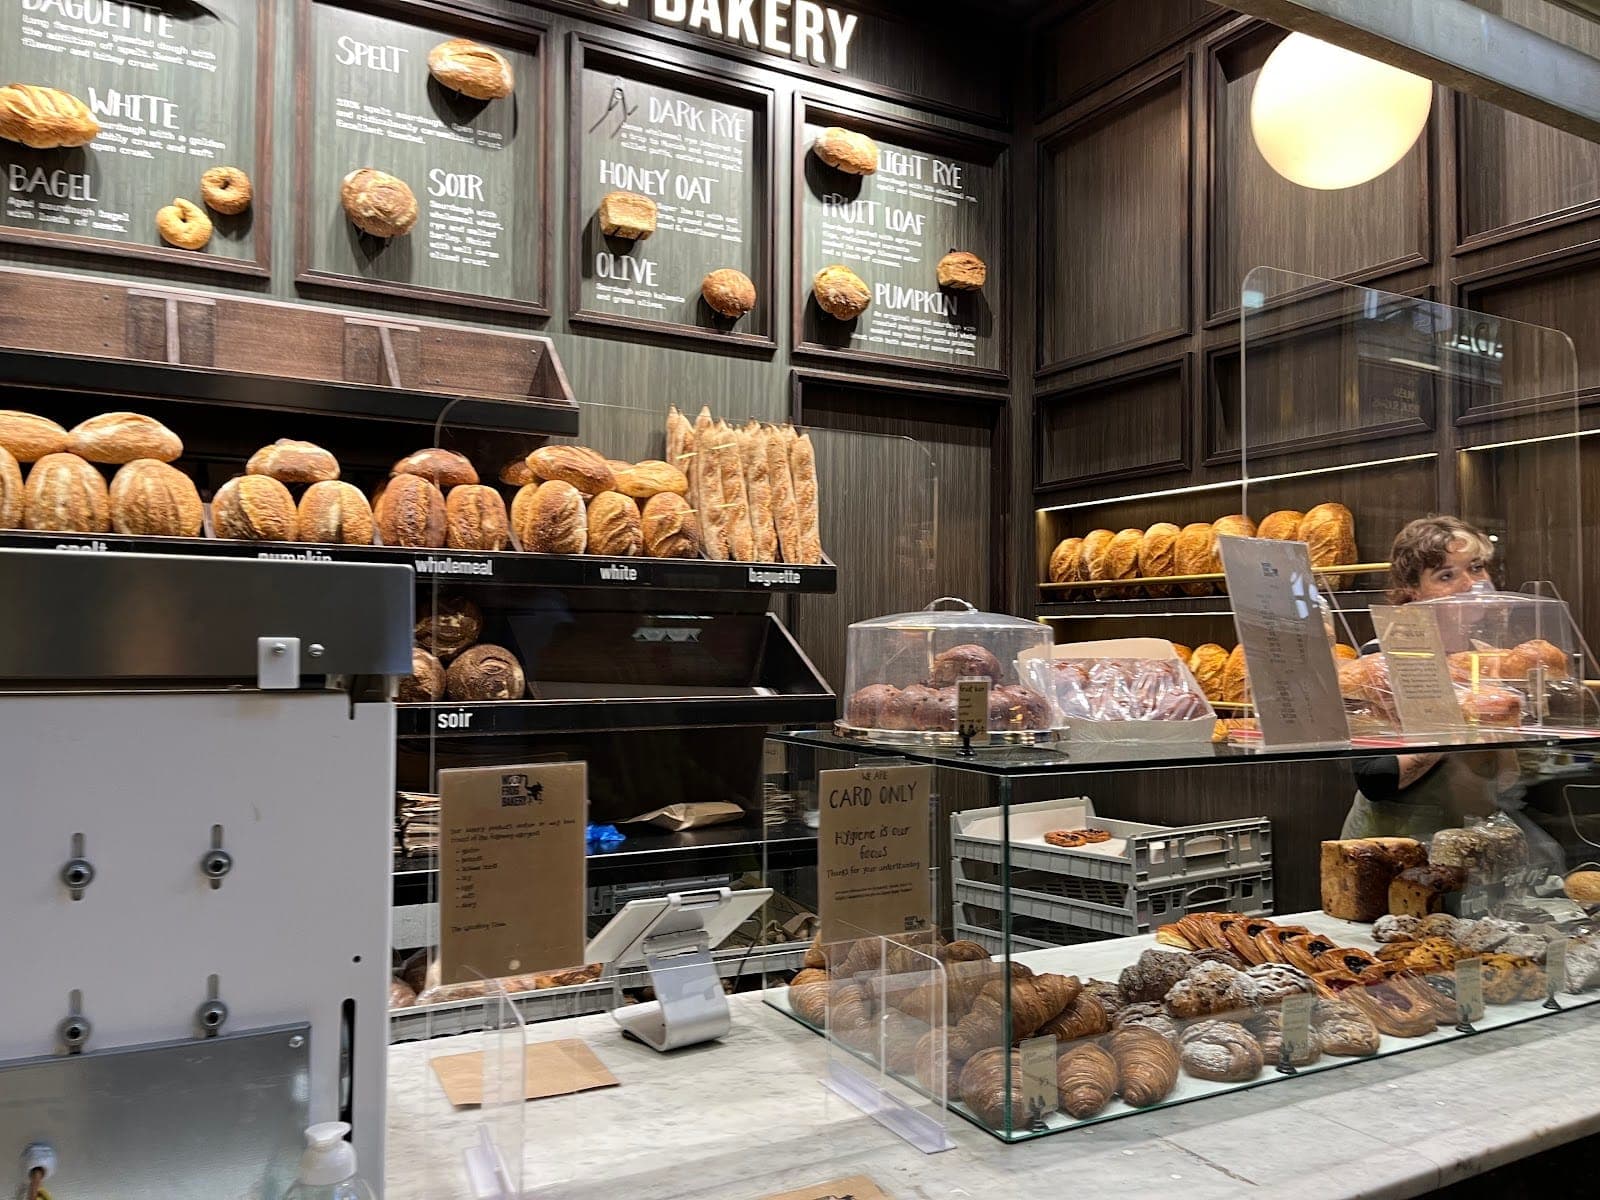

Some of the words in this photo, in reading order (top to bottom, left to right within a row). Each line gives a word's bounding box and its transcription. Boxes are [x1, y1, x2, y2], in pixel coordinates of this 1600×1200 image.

[335, 35, 409, 73] SPELT
[88, 87, 180, 129] WHITE
[649, 96, 705, 133] DARK
[711, 107, 748, 143] RYE
[9, 164, 98, 201] BAGEL
[427, 168, 484, 202] SOIR
[599, 159, 668, 197] HONEY
[675, 174, 719, 204] OAT
[878, 150, 928, 180] LIGHT
[932, 159, 962, 189] RYE
[822, 194, 881, 226] FRUIT
[885, 206, 926, 235] LOAF
[596, 251, 659, 287] OLIVE
[875, 283, 958, 316] PUMPKIN
[415, 557, 493, 575] wholemeal
[600, 565, 638, 581] white
[749, 568, 801, 586] baguette
[437, 708, 473, 728] soir
[829, 786, 872, 809] CARD
[880, 782, 917, 804] ONLY
[834, 828, 875, 846] Hygiene
[879, 825, 888, 836] is
[892, 826, 911, 836] our
[860, 845, 888, 860] focus
